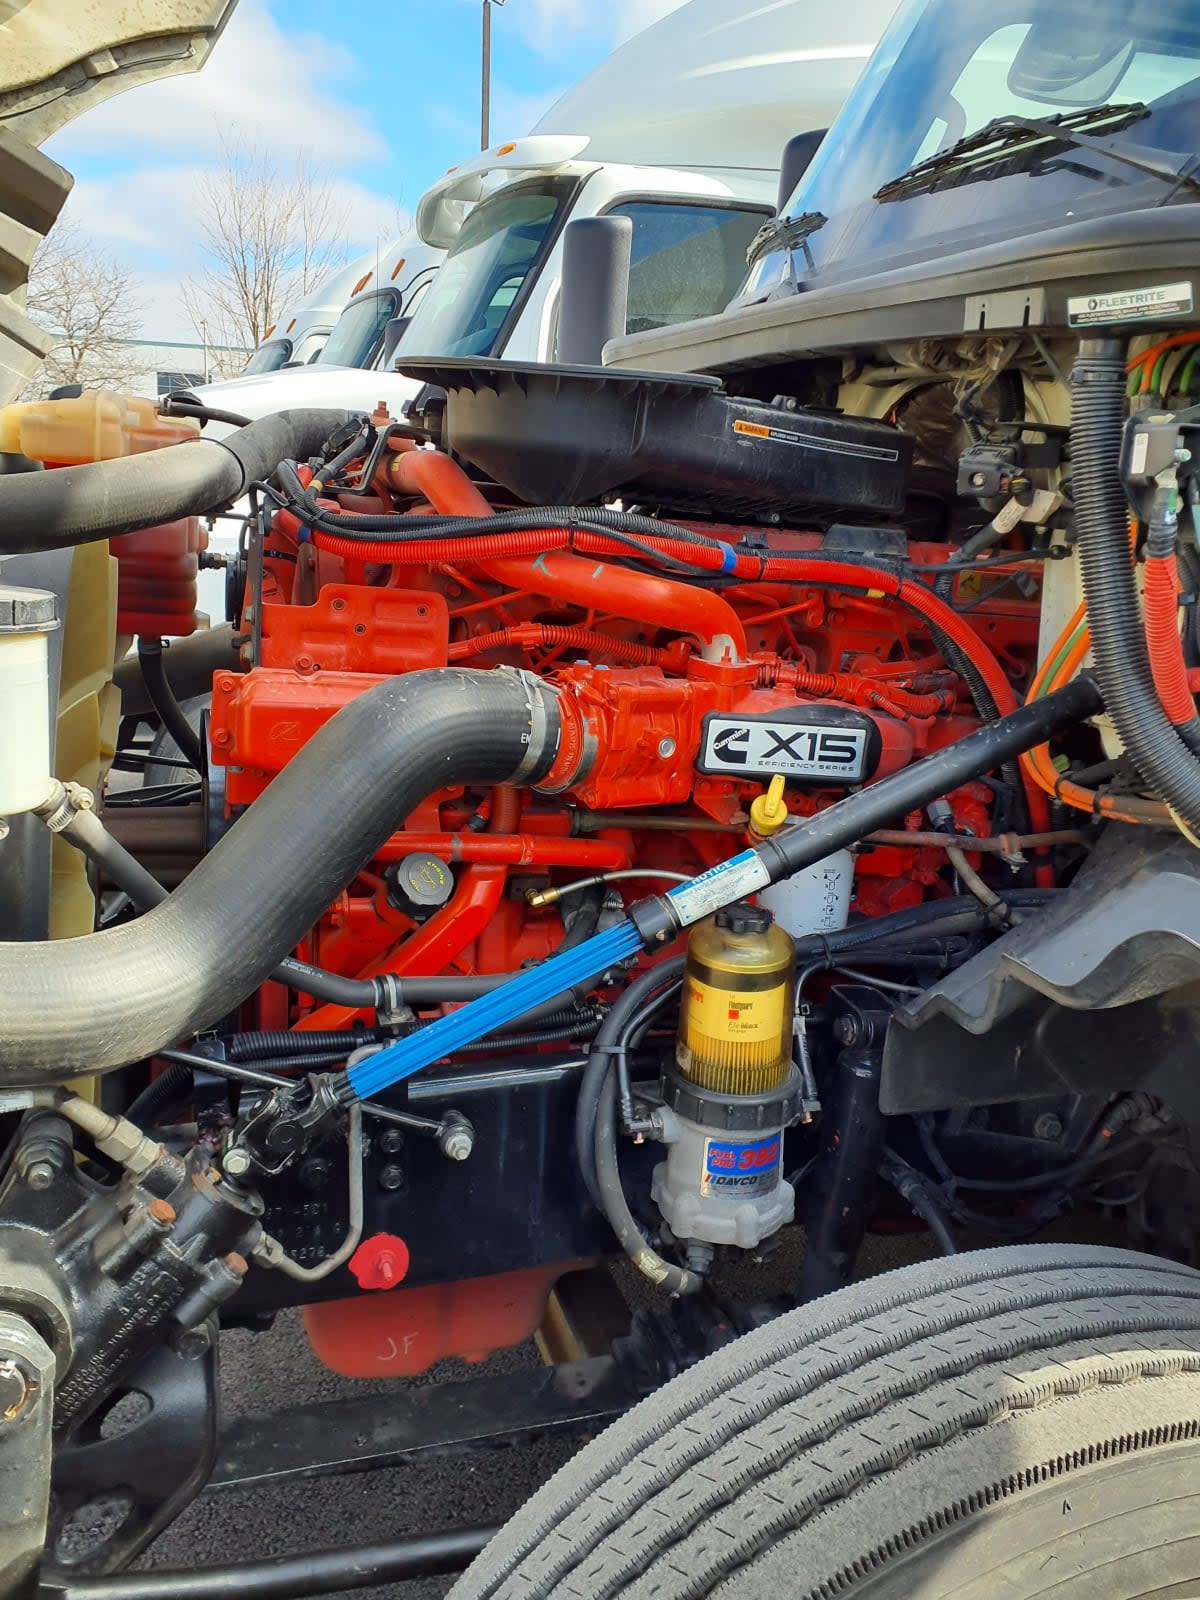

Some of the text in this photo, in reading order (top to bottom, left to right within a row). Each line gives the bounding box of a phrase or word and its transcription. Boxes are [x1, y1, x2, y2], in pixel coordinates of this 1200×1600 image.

[1099, 290, 1166, 308] FLEETRITE
[713, 727, 749, 750] Cummins
[760, 729, 857, 764] X15
[757, 760, 855, 772] EFFICIENCY SERIES
[690, 860, 735, 885] NOTICE
[738, 1141, 779, 1169] 382
[716, 1175, 758, 1186] DAVCO
